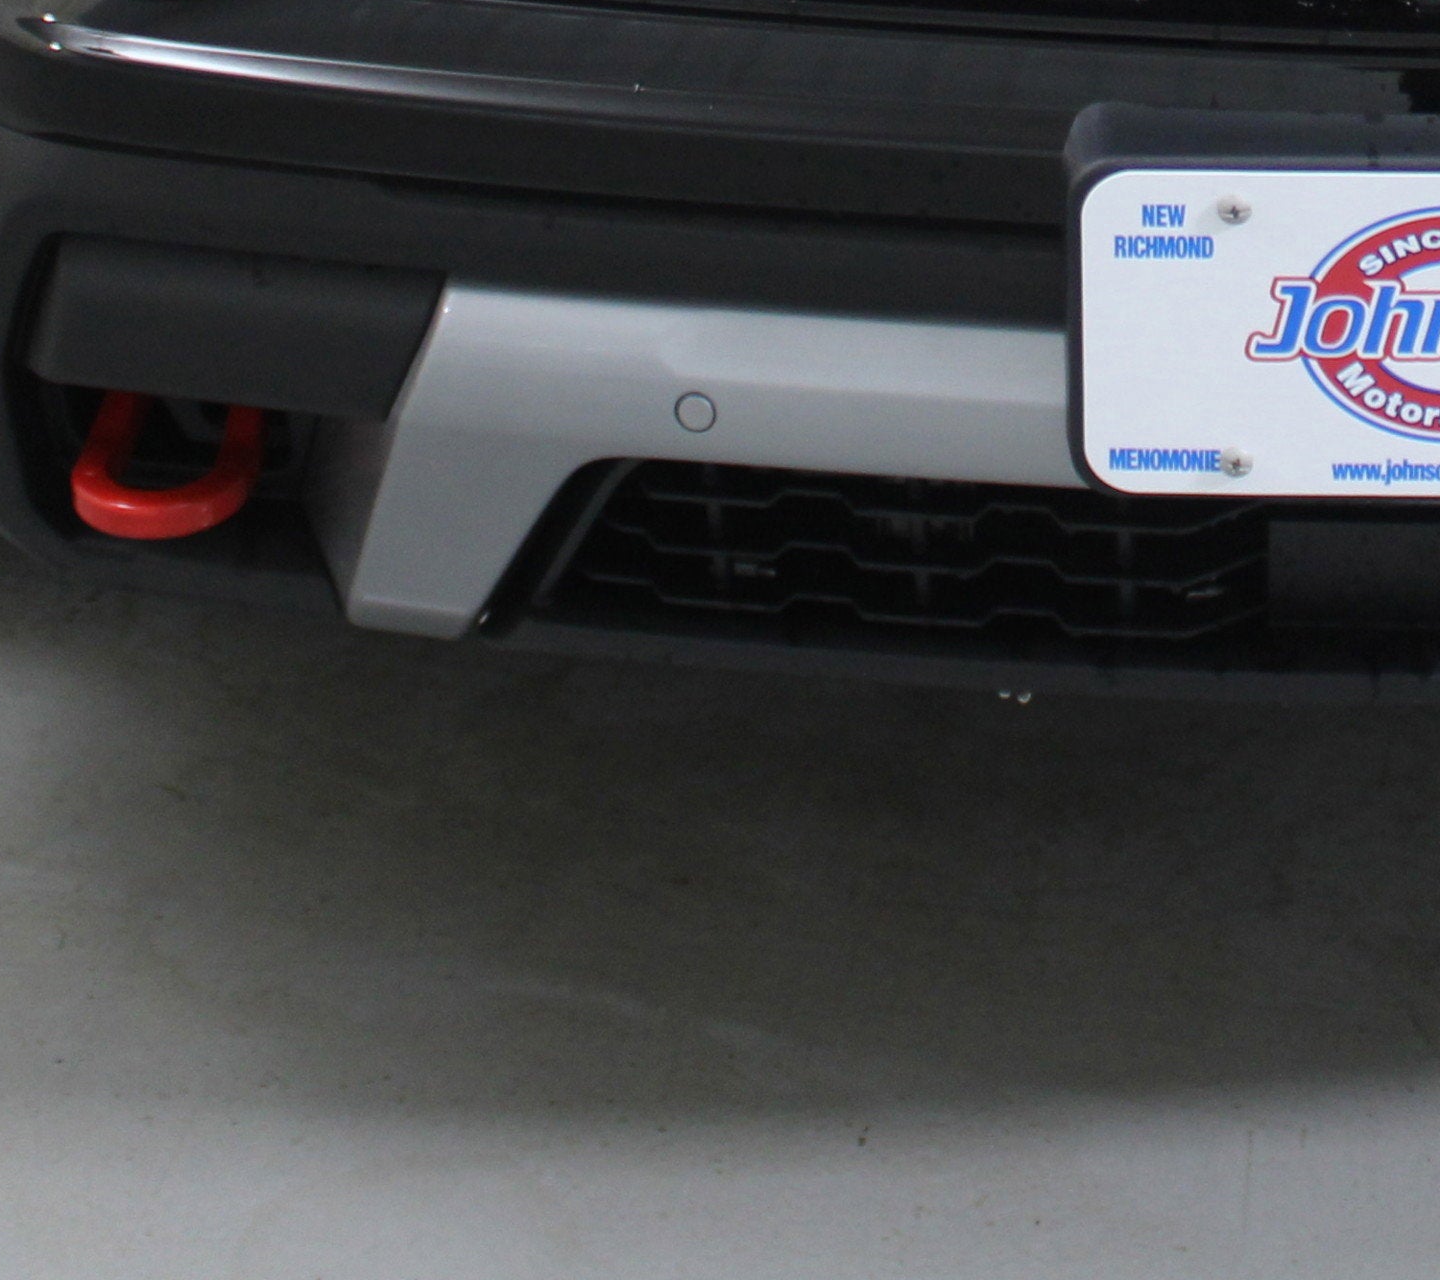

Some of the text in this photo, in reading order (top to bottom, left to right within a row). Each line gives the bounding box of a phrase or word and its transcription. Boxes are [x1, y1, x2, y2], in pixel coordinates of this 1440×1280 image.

[1141, 204, 1186, 227] NEW
[1113, 236, 1214, 260] RICHMOND
[1108, 448, 1221, 473] MENOMONIE
